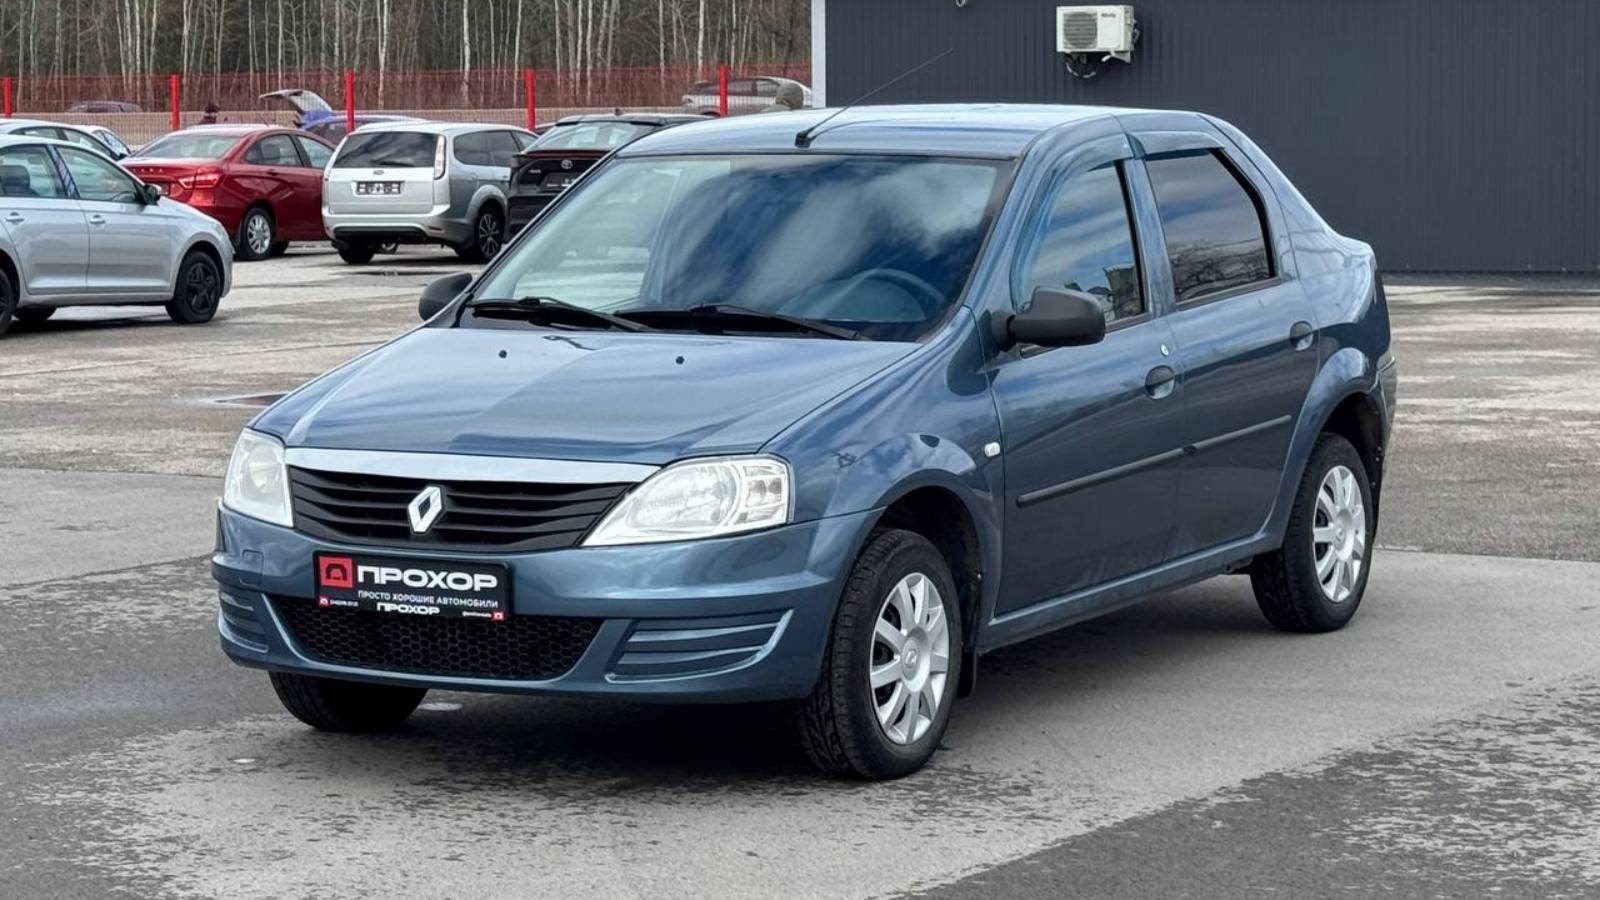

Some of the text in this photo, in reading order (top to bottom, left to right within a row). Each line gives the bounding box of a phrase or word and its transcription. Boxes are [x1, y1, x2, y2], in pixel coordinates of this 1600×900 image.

[357, 565, 498, 592] ПРОХОР
[358, 590, 498, 608] ПРОСТО ХОРОШИЕ АВТОМОБИЛИ
[376, 602, 441, 615] ПРОХОР
